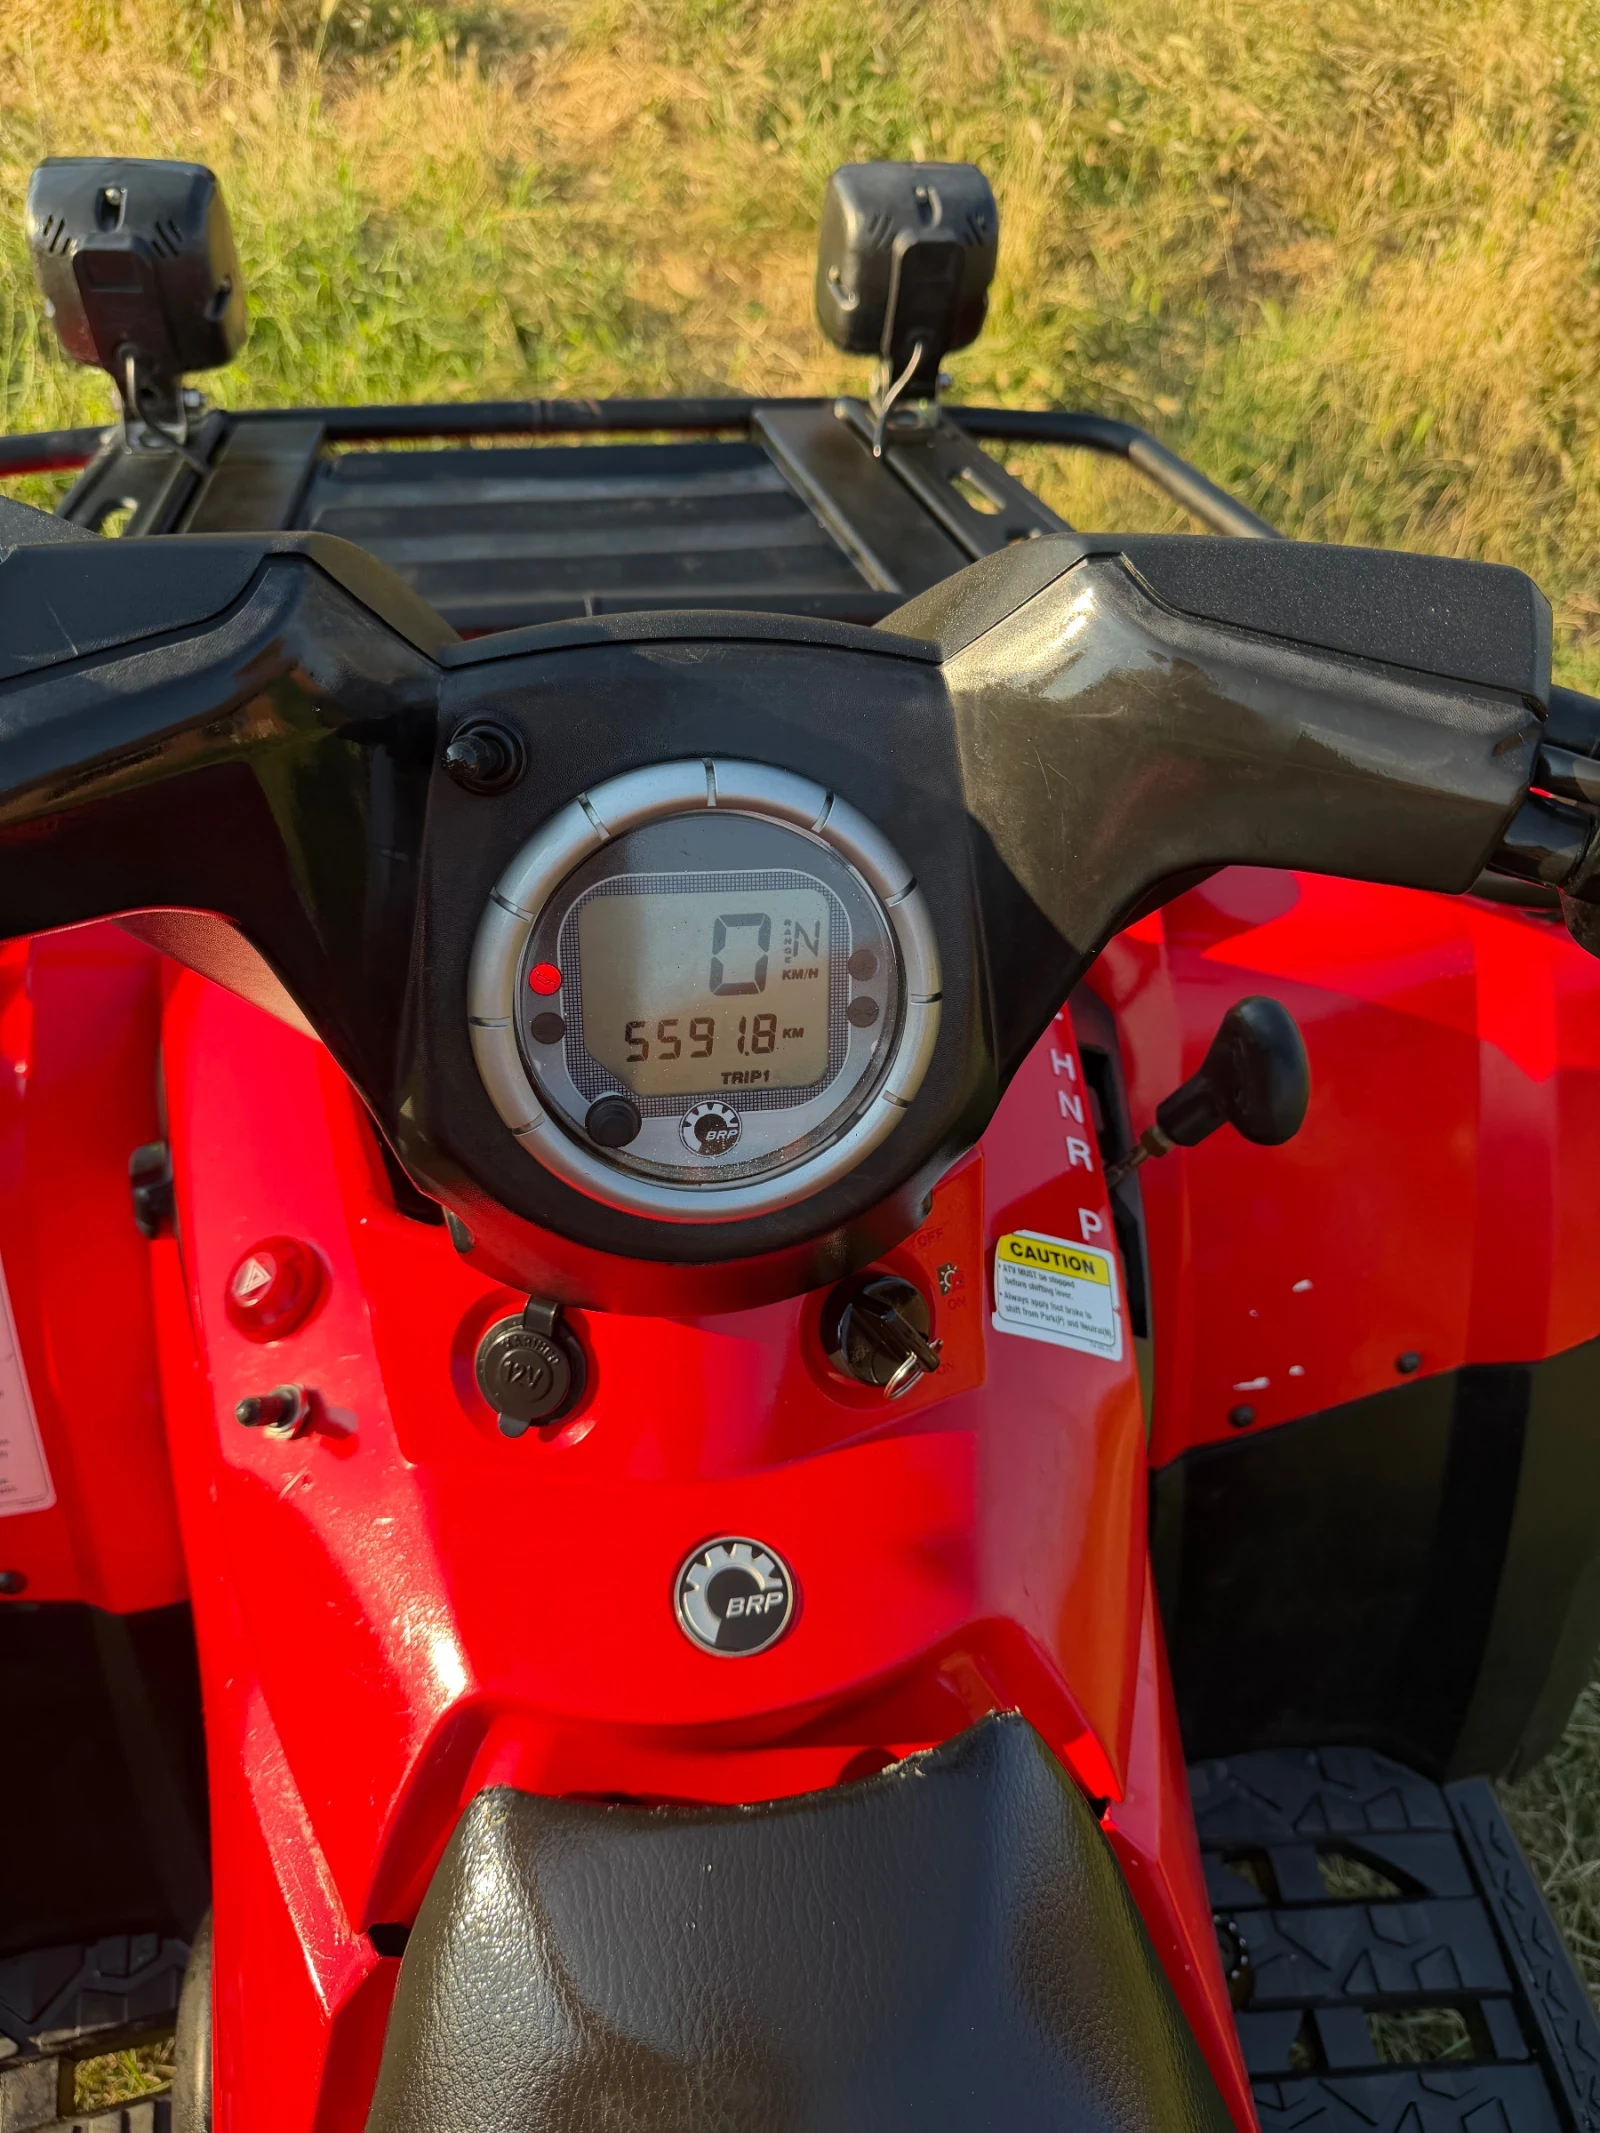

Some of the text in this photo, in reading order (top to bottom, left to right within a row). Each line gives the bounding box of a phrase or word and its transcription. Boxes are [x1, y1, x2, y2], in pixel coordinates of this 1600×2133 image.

[709, 912, 772, 996] 0
[783, 919, 792, 964] RANGE
[793, 919, 820, 957] N
[782, 968, 819, 980] KM/H
[625, 1013, 805, 1062] 5591.8 KM
[1050, 1048, 1077, 1081] H
[1058, 1090, 1085, 1124] N
[705, 1129, 739, 1141] BRP
[1066, 1136, 1094, 1172] R
[1078, 1207, 1103, 1240] P
[1010, 1241, 1095, 1275] CAUTION
[1003, 1264, 1016, 1273] ATV
[1017, 1268, 1037, 1279] MUST
[1048, 1276, 1075, 1288] stopped
[1004, 1277, 1027, 1288] before
[1028, 1283, 1054, 1296] shifting
[1004, 1292, 1029, 1304] Always
[1031, 1298, 1049, 1310] apply
[503, 1360, 543, 1389] 12V
[726, 1592, 783, 1618] BRP
